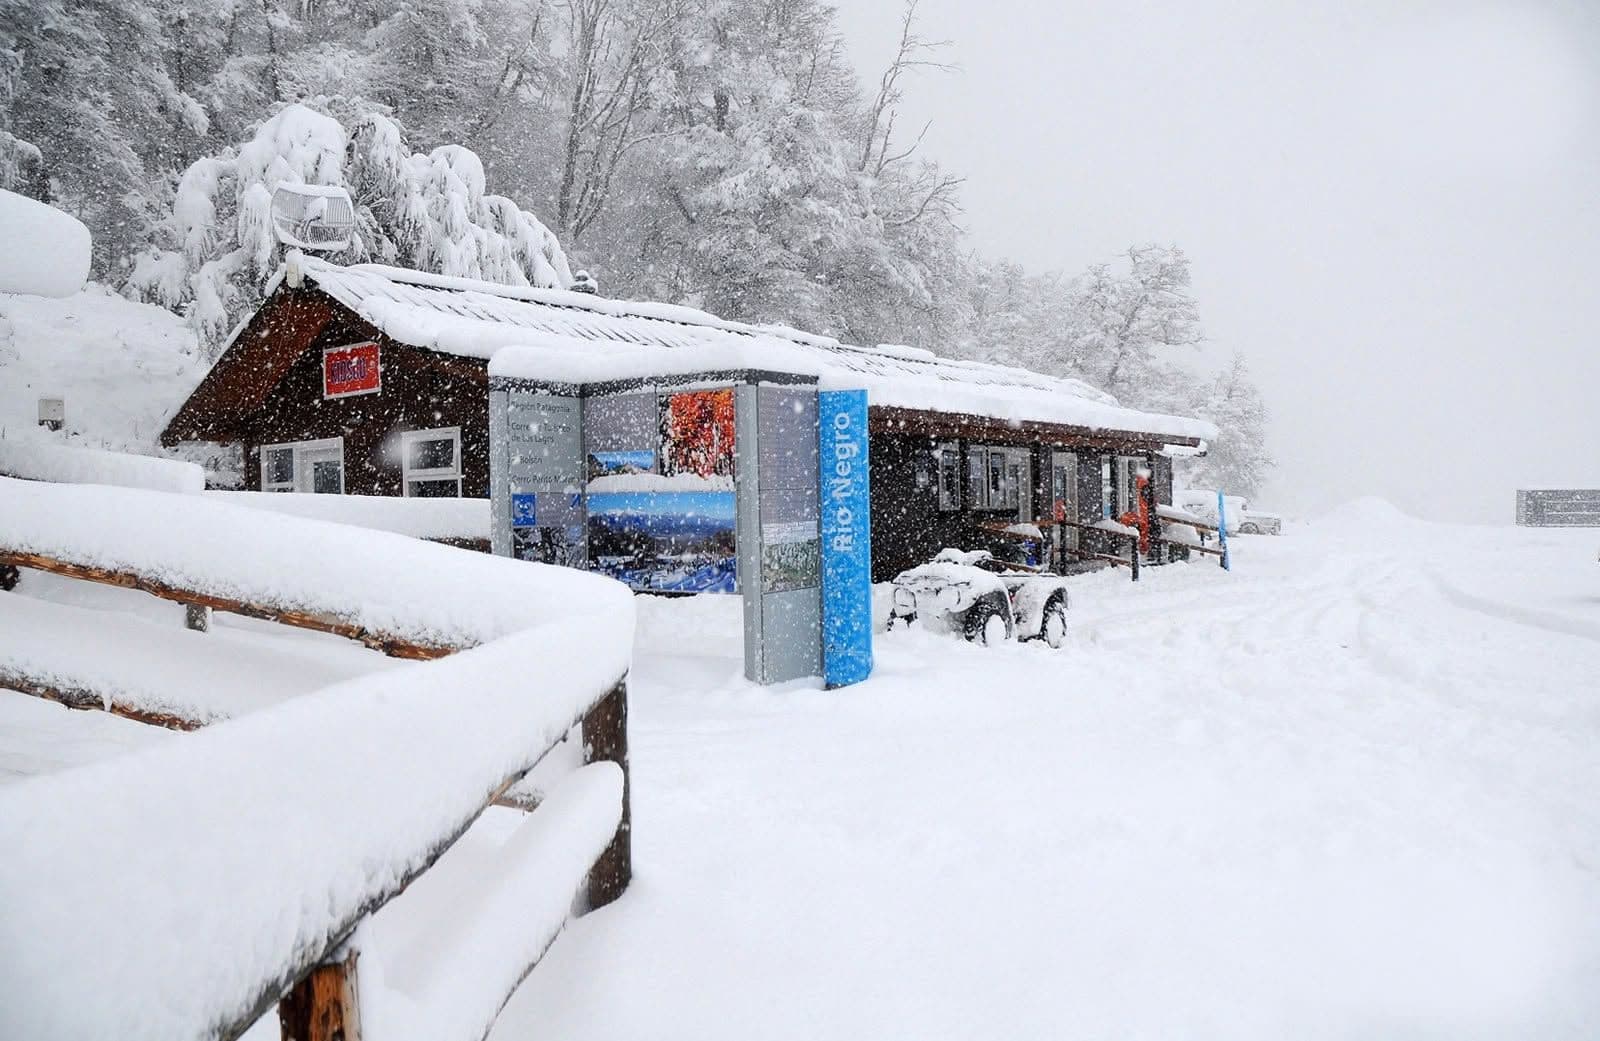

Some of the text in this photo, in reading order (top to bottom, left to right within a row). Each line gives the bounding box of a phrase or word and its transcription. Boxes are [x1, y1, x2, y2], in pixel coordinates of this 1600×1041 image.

[536, 402, 571, 414] Patagonia
[511, 422, 541, 431] Correr
[511, 434, 521, 442] de
[831, 412, 859, 498] Negro
[554, 475, 581, 485] Mreno
